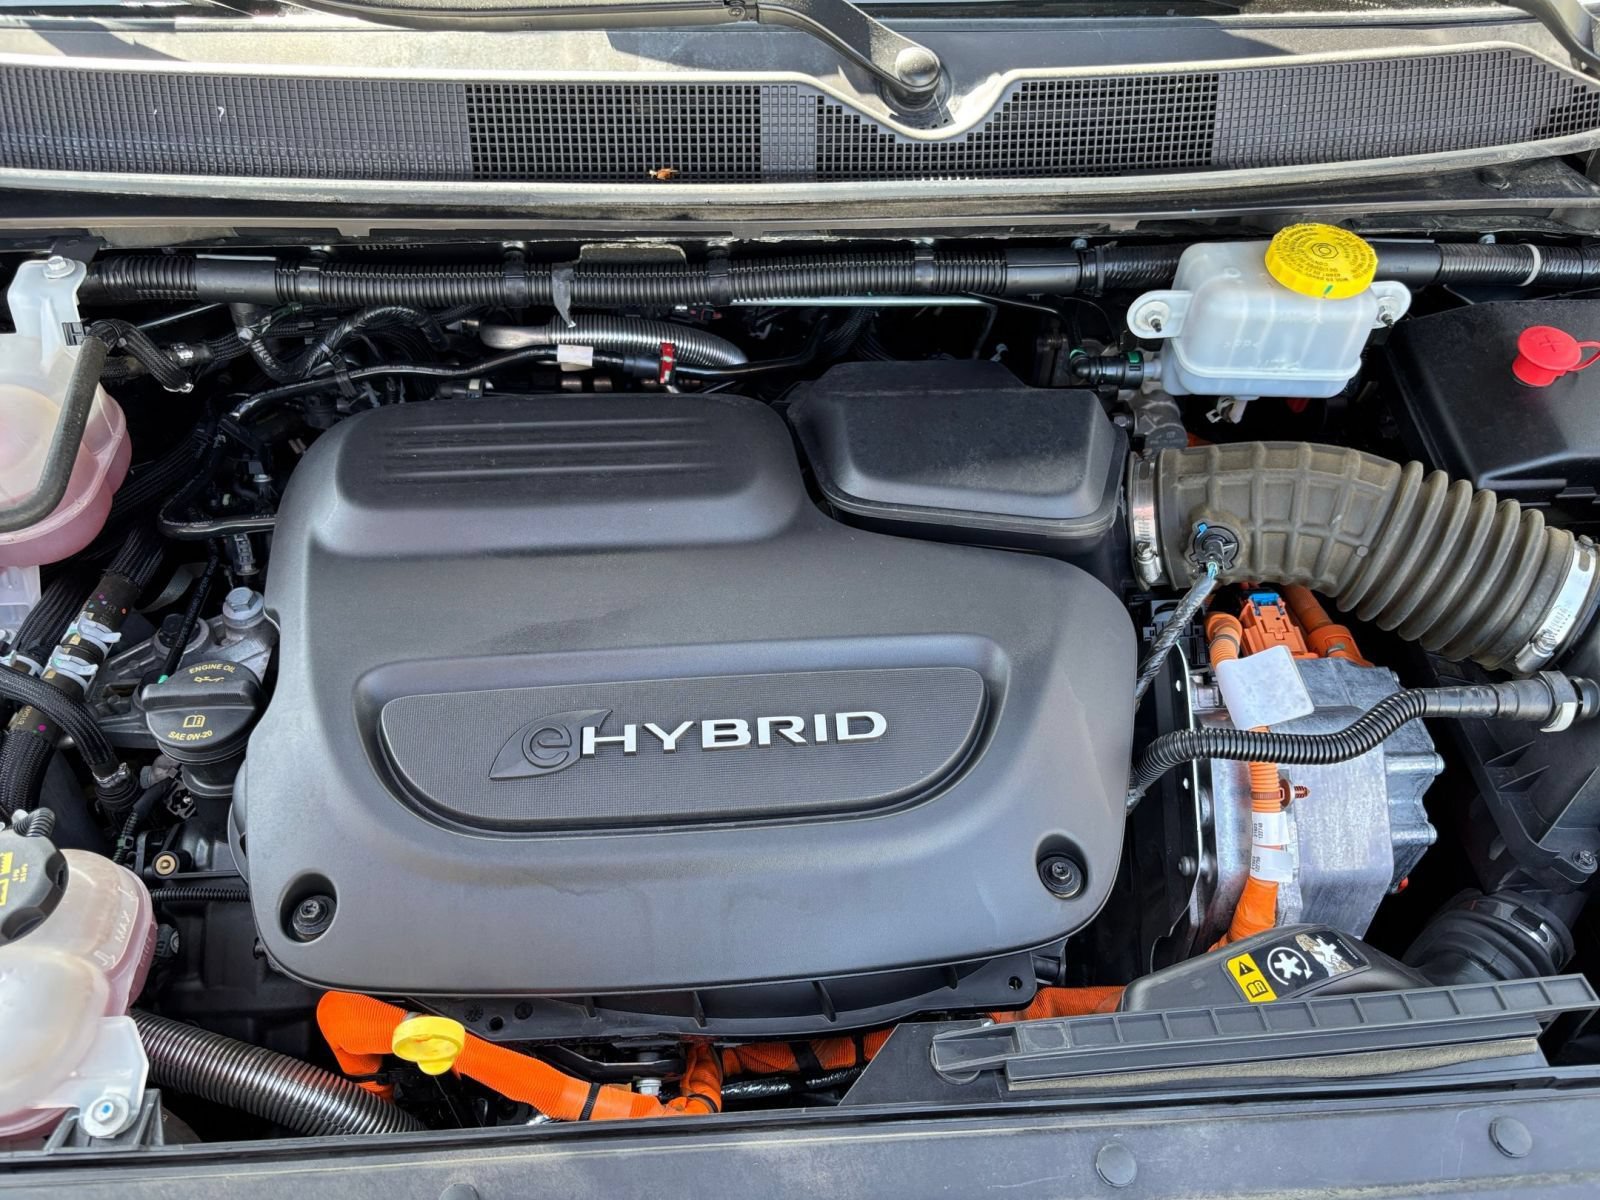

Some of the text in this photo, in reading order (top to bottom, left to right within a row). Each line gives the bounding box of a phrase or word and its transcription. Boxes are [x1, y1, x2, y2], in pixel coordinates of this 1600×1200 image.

[189, 663, 236, 674] ENGINE OIL
[168, 730, 185, 741] SAE
[114, 910, 131, 943] MAX
